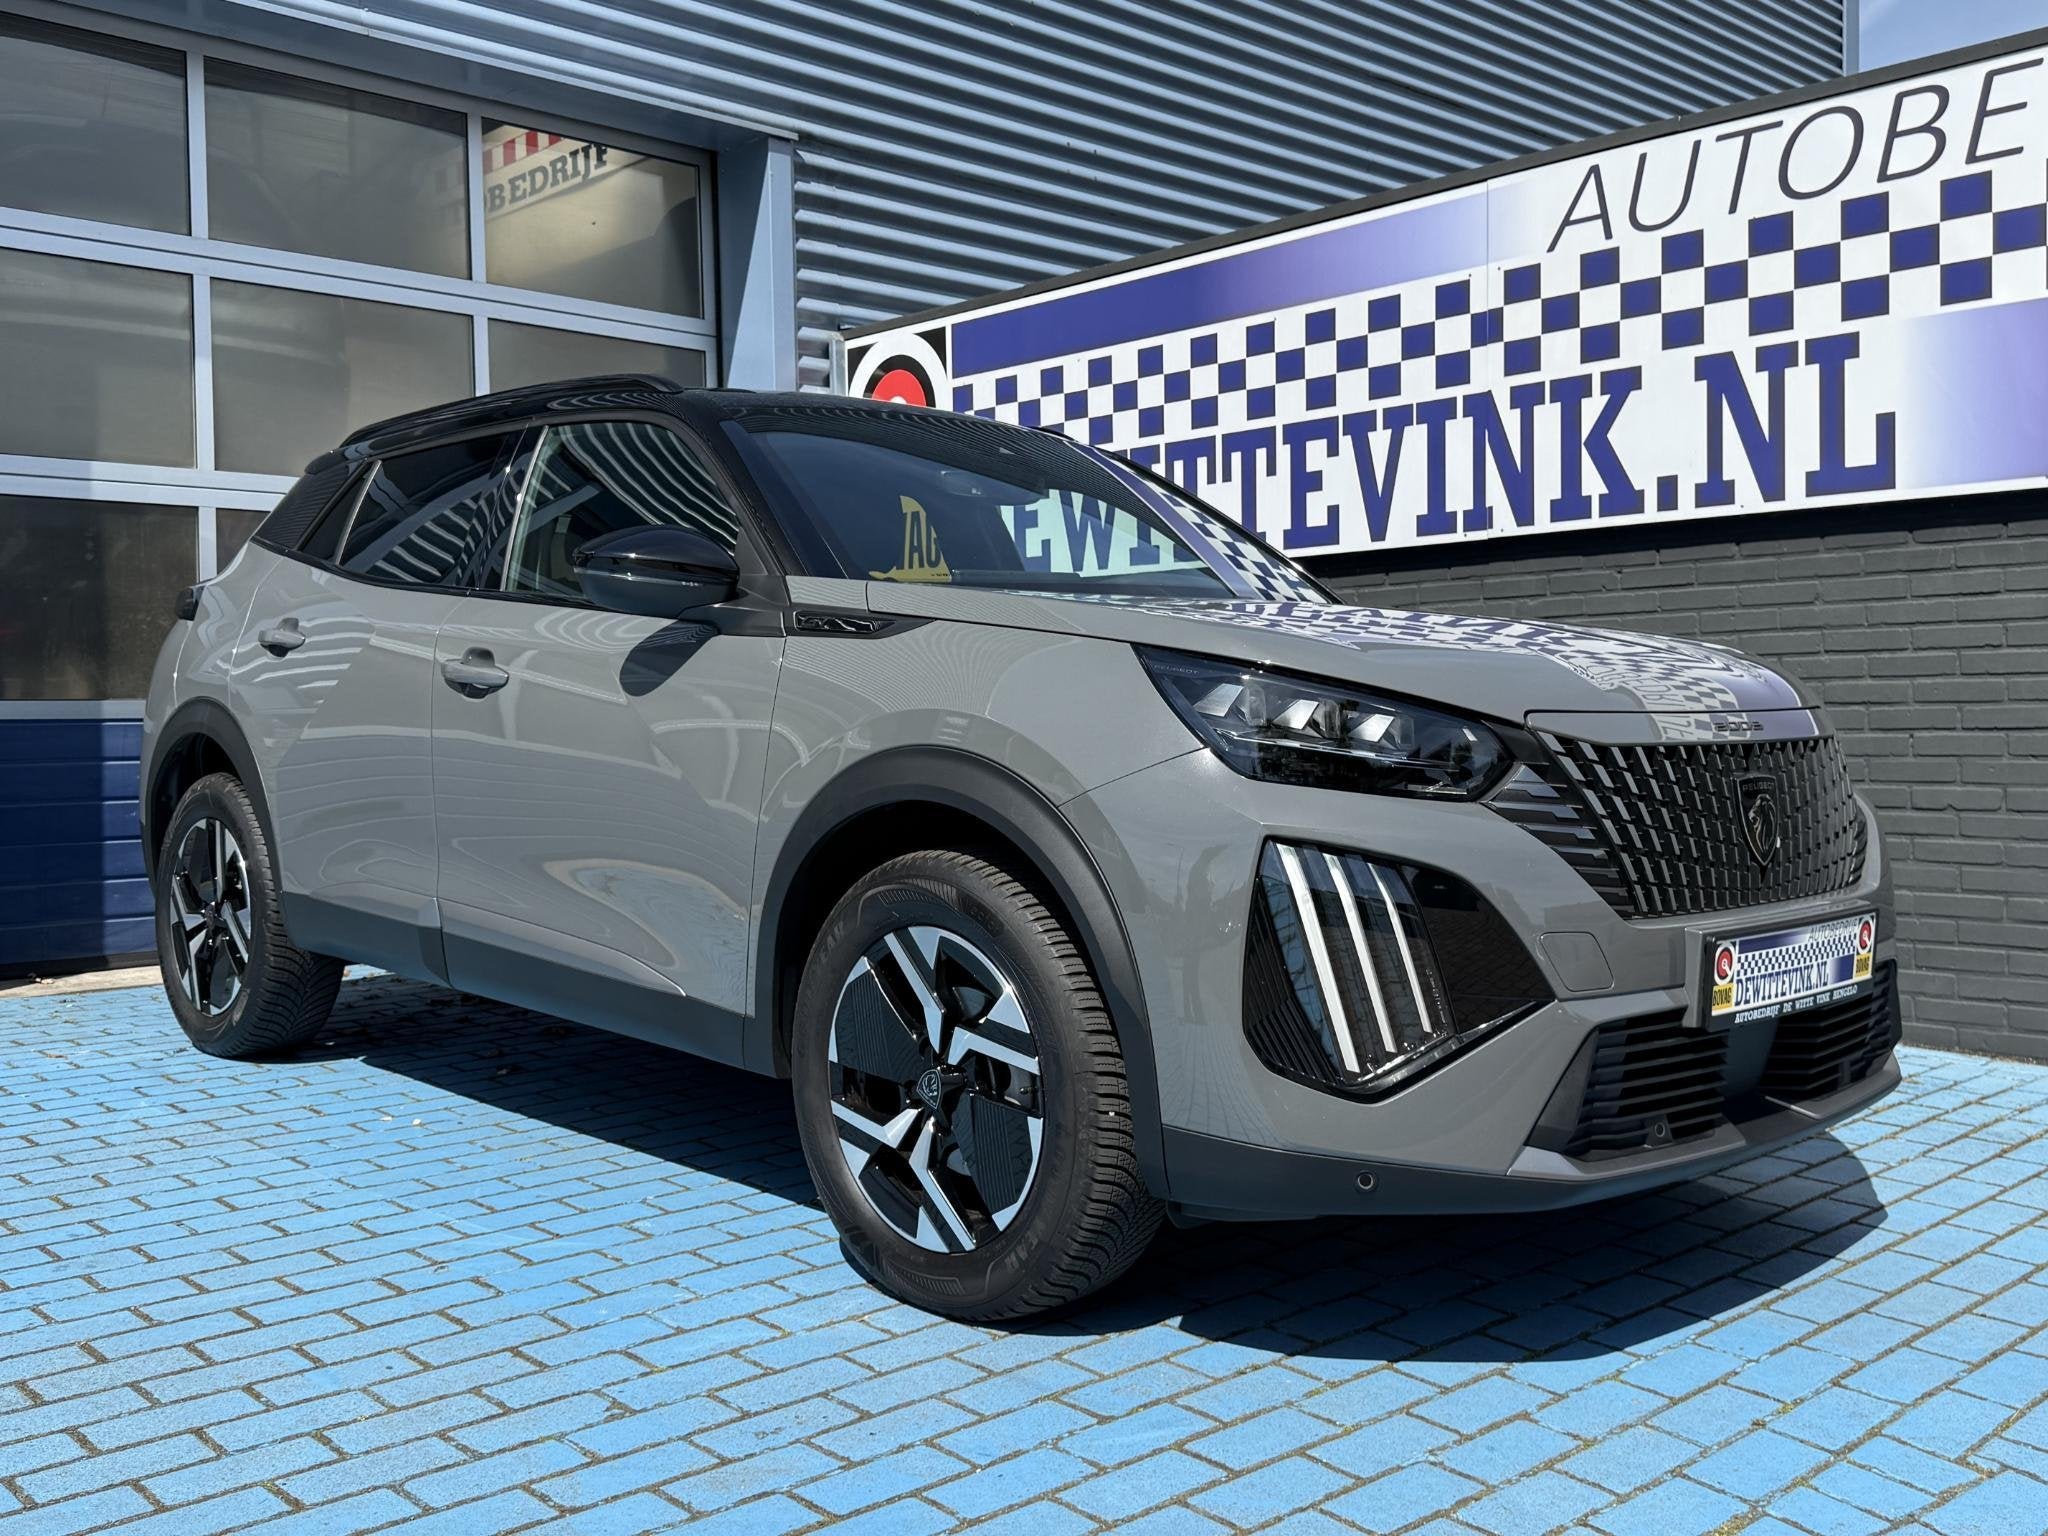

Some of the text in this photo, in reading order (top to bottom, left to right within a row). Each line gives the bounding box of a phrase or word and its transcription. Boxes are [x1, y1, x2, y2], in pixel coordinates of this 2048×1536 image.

[1547, 57, 2044, 253] AUTOBE
[485, 143, 608, 213] BEDRIJF
[1808, 918, 1858, 942] AUTOBEDRIJF
[1712, 987, 1732, 1006] BOVAG
[1734, 961, 1829, 1006] DEWITTEVINK.NL
[1734, 1004, 1780, 1023] AUTOBEDRIJF
[1783, 1000, 1793, 1013] DE
[1795, 996, 1815, 1010] WITTE
[1816, 991, 1831, 1004] VINK
